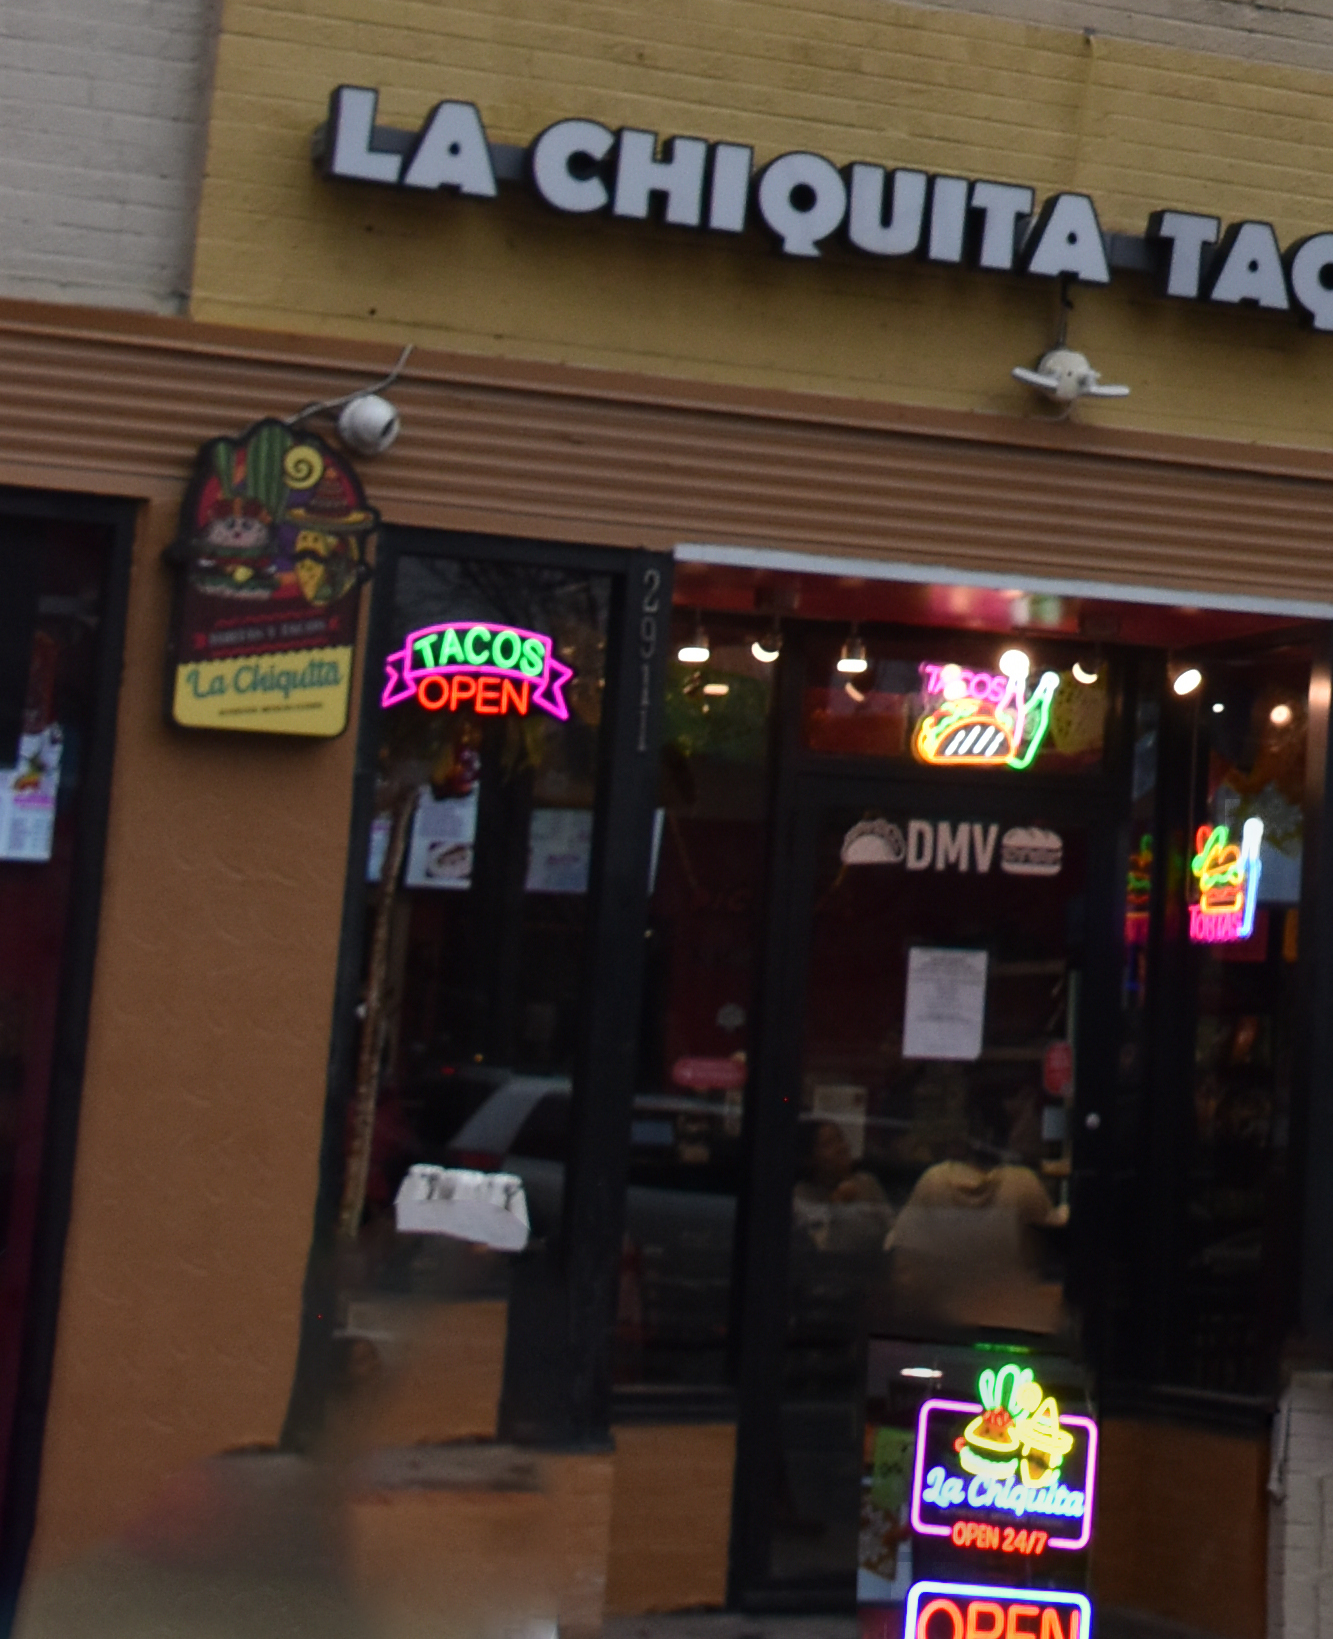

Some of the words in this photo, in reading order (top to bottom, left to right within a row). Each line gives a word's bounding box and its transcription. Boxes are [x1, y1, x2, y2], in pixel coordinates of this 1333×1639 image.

[327, 84, 498, 198] LA
[530, 116, 1111, 284] CHIQUITA
[413, 626, 546, 677] TACOS
[186, 668, 227, 700] La
[233, 659, 342, 699] Chiquita
[417, 674, 530, 716] OPEN
[905, 818, 999, 873] DMV
[922, 1466, 966, 1508] La
[967, 1473, 1085, 1518] Chiquita
[951, 1521, 1000, 1551] OPEN
[1001, 1527, 1048, 1555] 24/7
